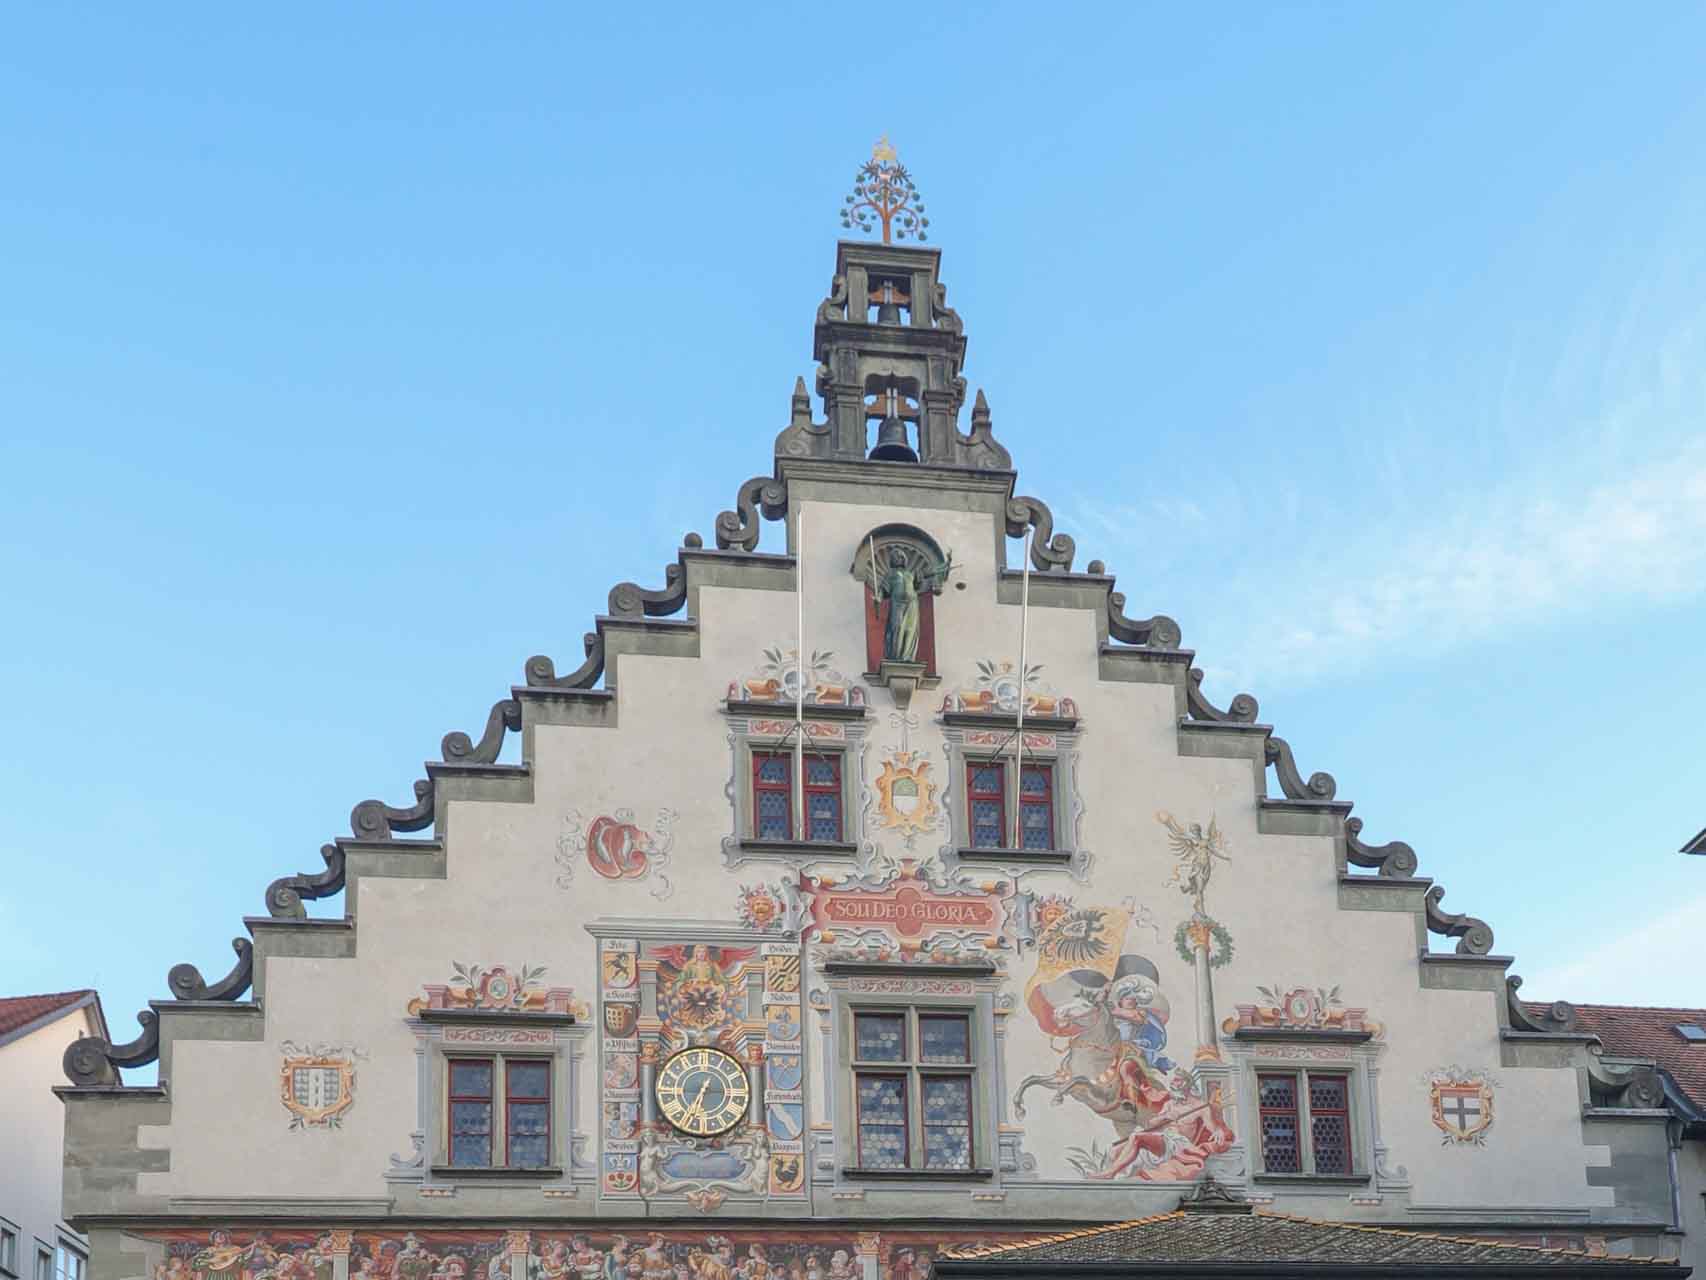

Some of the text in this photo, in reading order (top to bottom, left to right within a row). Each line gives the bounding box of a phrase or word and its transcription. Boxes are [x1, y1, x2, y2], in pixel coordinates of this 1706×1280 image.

[836, 901, 978, 922] SOLI DEO GLORIA
